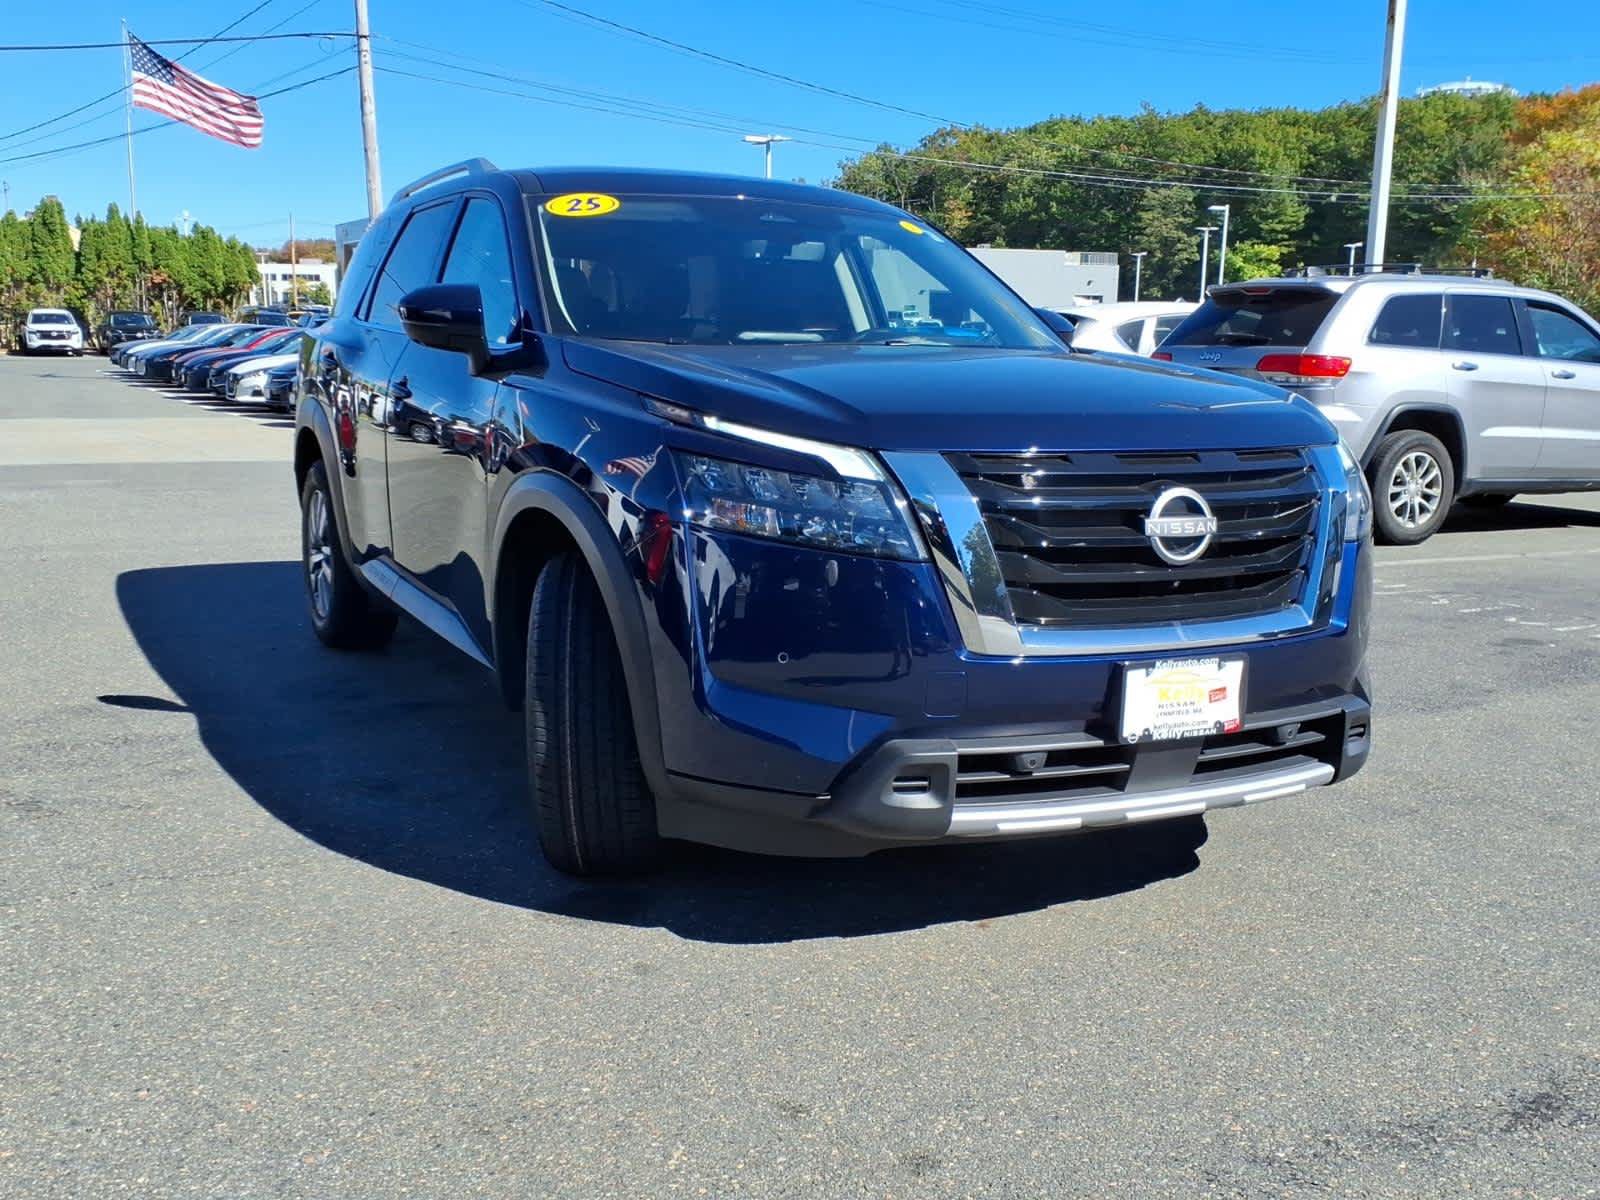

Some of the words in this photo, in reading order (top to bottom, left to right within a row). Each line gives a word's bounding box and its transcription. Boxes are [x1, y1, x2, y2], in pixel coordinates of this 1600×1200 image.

[567, 197, 600, 212] 25
[1148, 520, 1216, 534] NISSAN
[1155, 657, 1219, 670] Kellyauto.com
[1158, 687, 1204, 702] Kelly
[1158, 701, 1196, 710] NISSAN
[1152, 729, 1182, 740] Kelly
[1183, 728, 1217, 737] NISSAN
